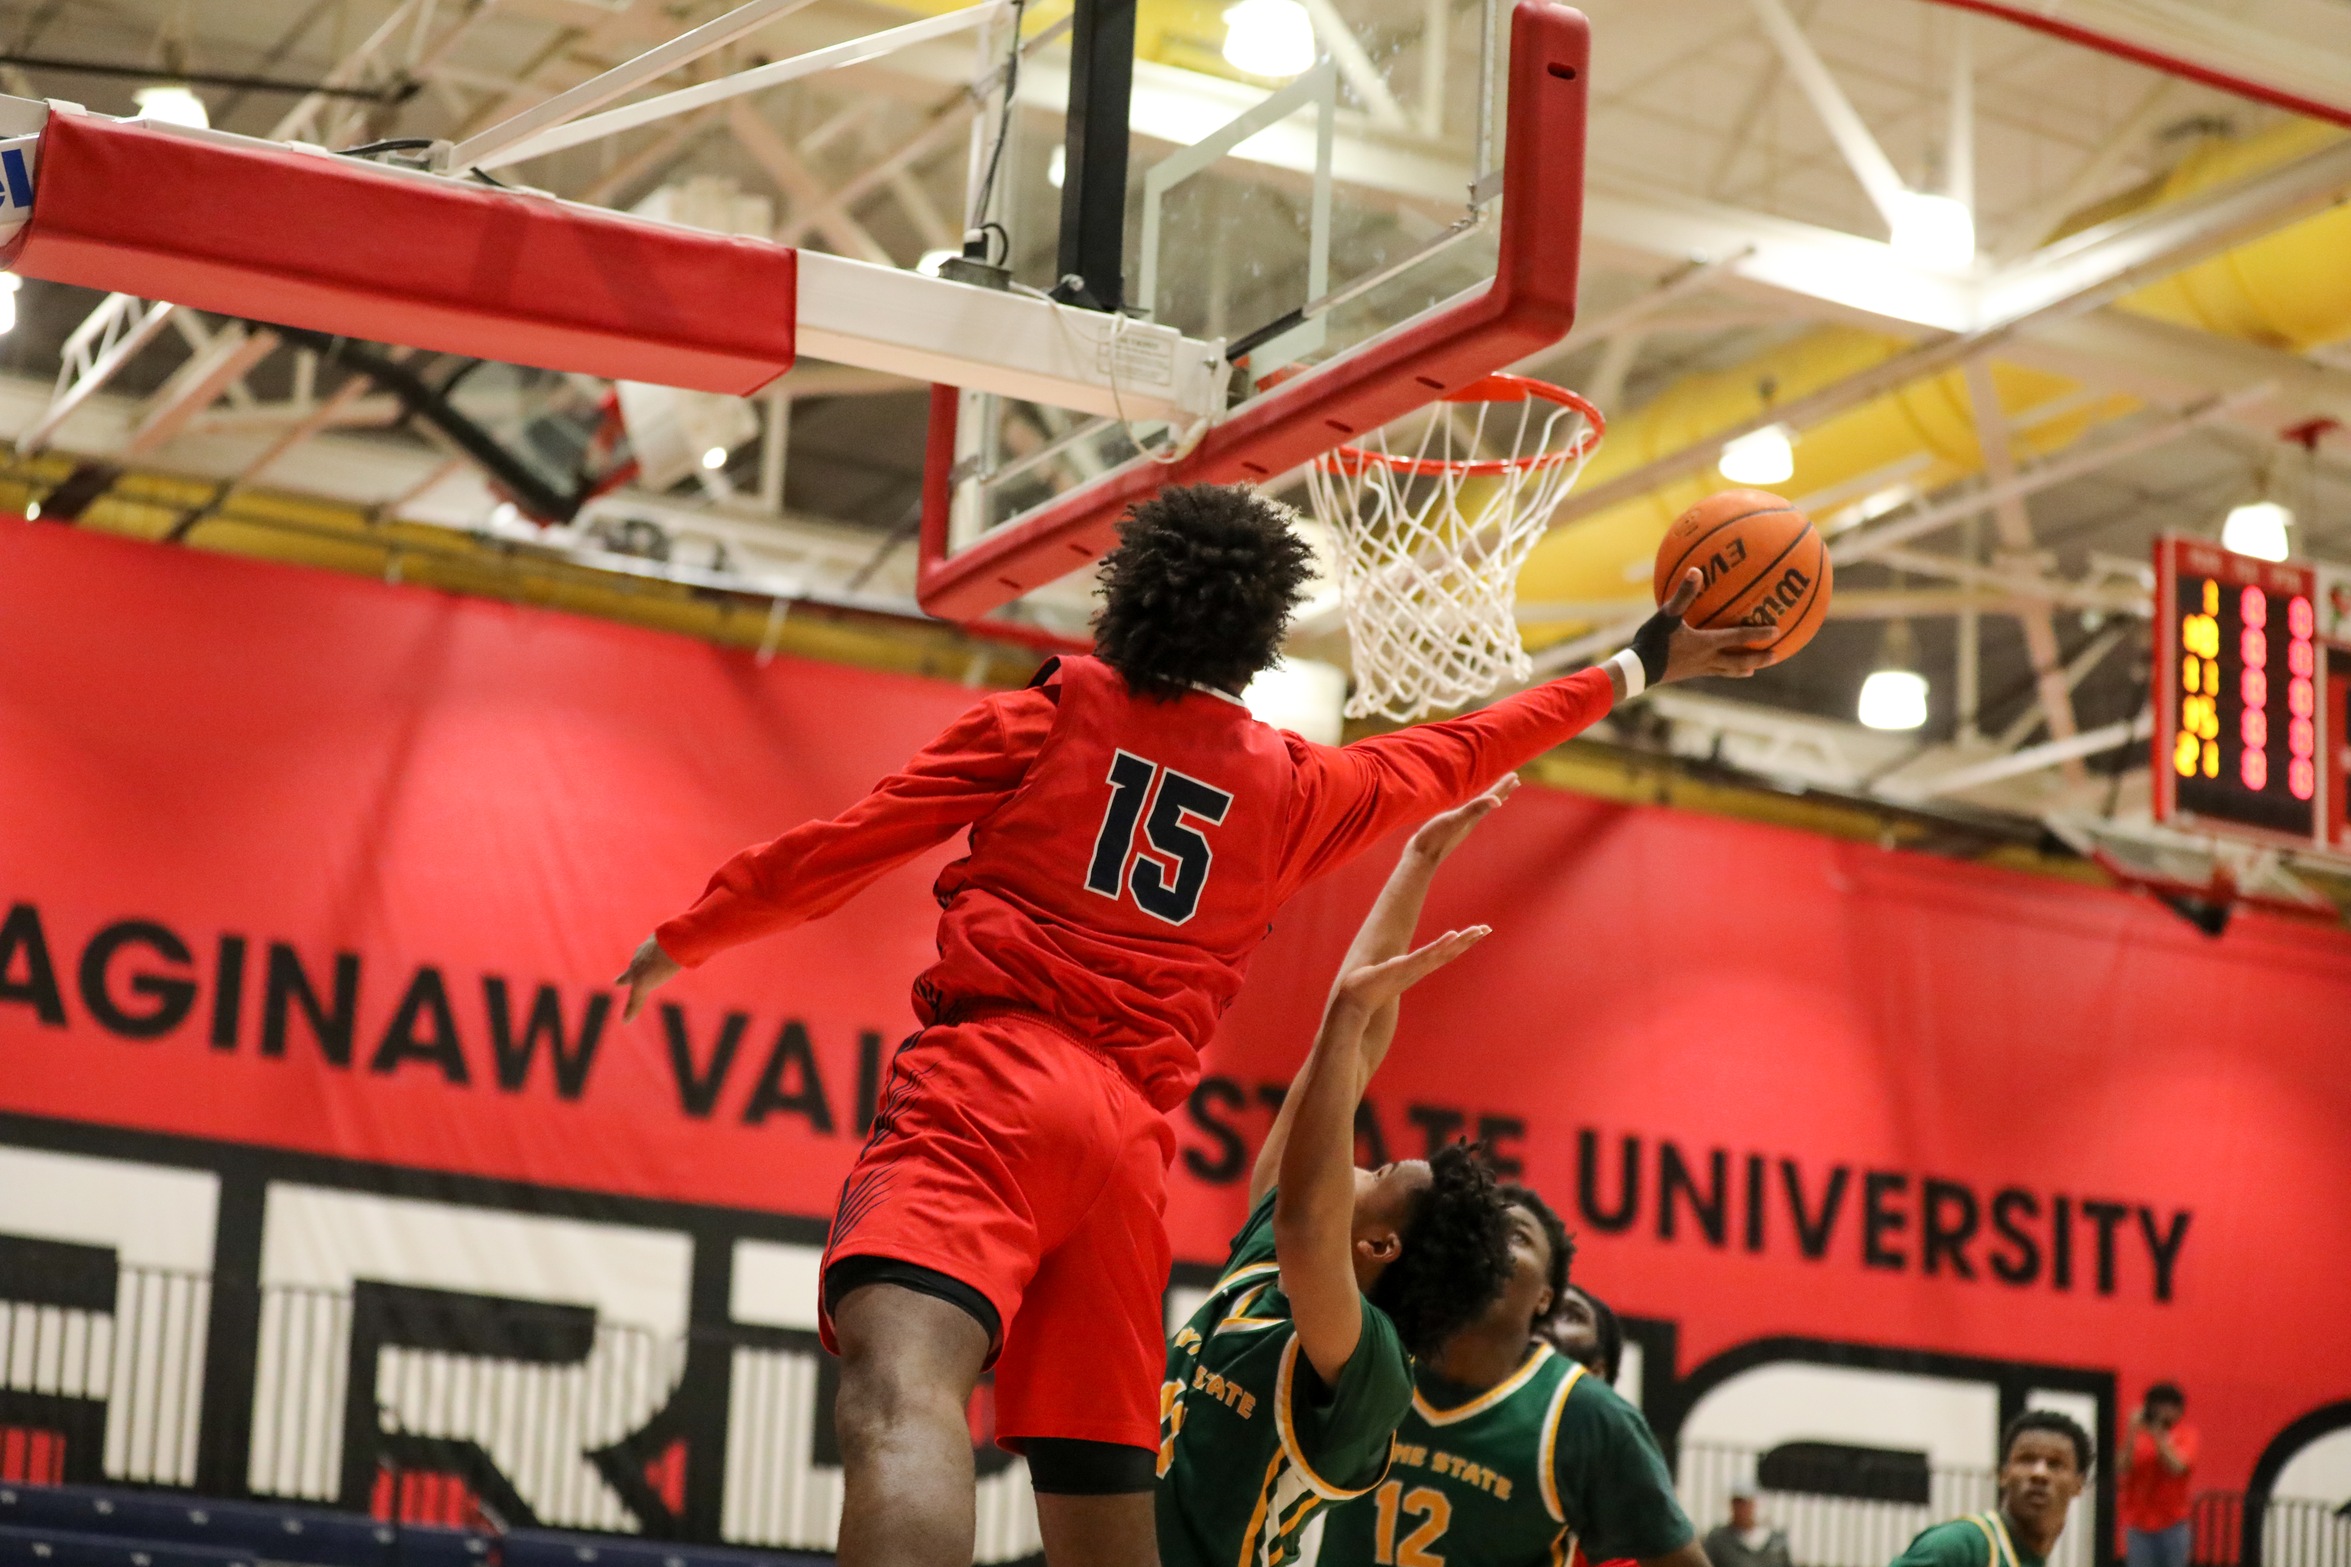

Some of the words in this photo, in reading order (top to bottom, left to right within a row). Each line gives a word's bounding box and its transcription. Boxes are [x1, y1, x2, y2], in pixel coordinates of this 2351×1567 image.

[1740, 568, 1811, 627] Wil
[1084, 748, 1234, 927] 15
[0, 903, 612, 1102] AGINAW
[1577, 1128, 2192, 1304] UNIVERSITY
[1431, 1451, 1513, 1501] STATE
[1374, 1480, 1452, 1567] 12
